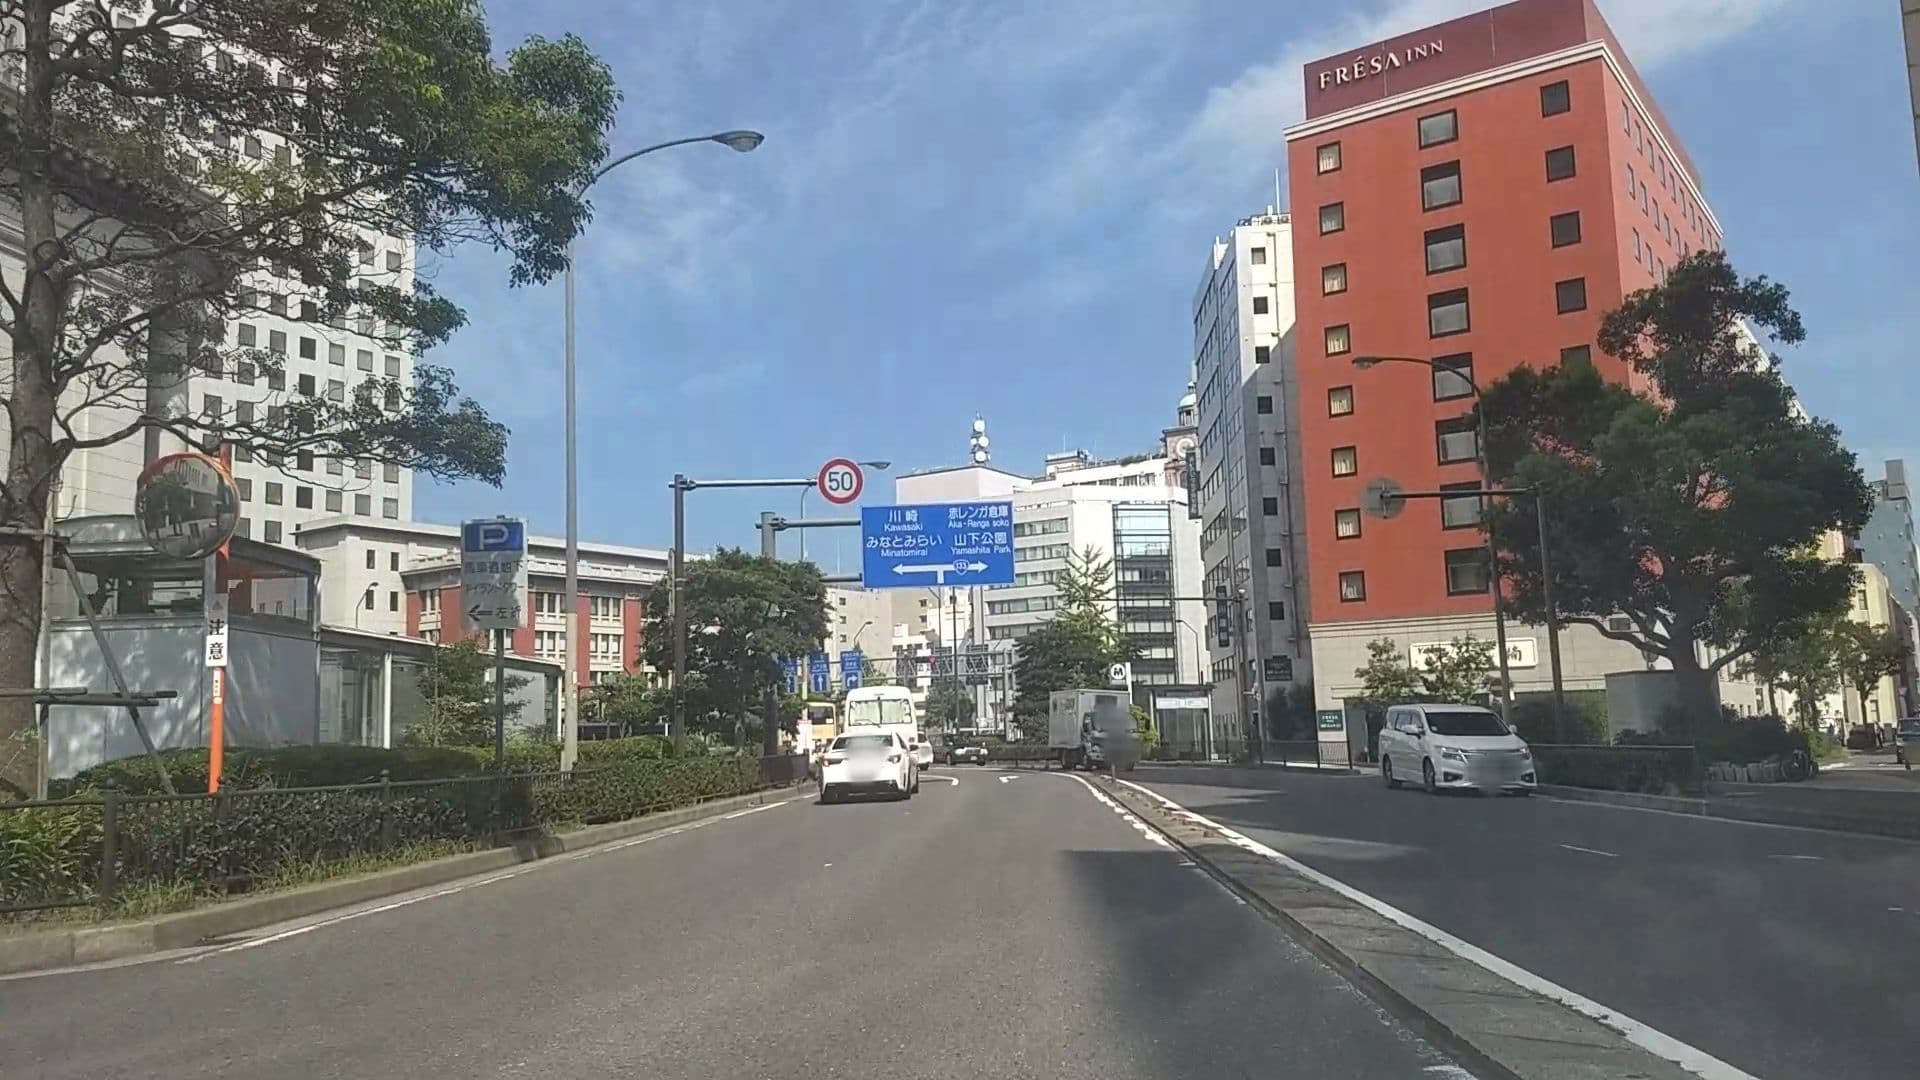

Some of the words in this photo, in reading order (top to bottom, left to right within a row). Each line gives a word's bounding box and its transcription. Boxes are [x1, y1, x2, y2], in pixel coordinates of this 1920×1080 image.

[1319, 53, 1400, 89] FRÉSA
[1406, 39, 1444, 62] INN
[828, 471, 853, 491] 50
[889, 509, 918, 522] 川崎
[948, 505, 1009, 519] 赤レンガ倉庫
[884, 522, 922, 532] Kawasaki
[479, 524, 509, 550] P
[866, 534, 943, 548] みなとみらい
[954, 531, 1007, 546] 山下公園
[881, 548, 928, 557] Minatomirai
[951, 546, 991, 555] Yamashita
[993, 545, 1011, 554] Park
[496, 605, 521, 619] 左折
